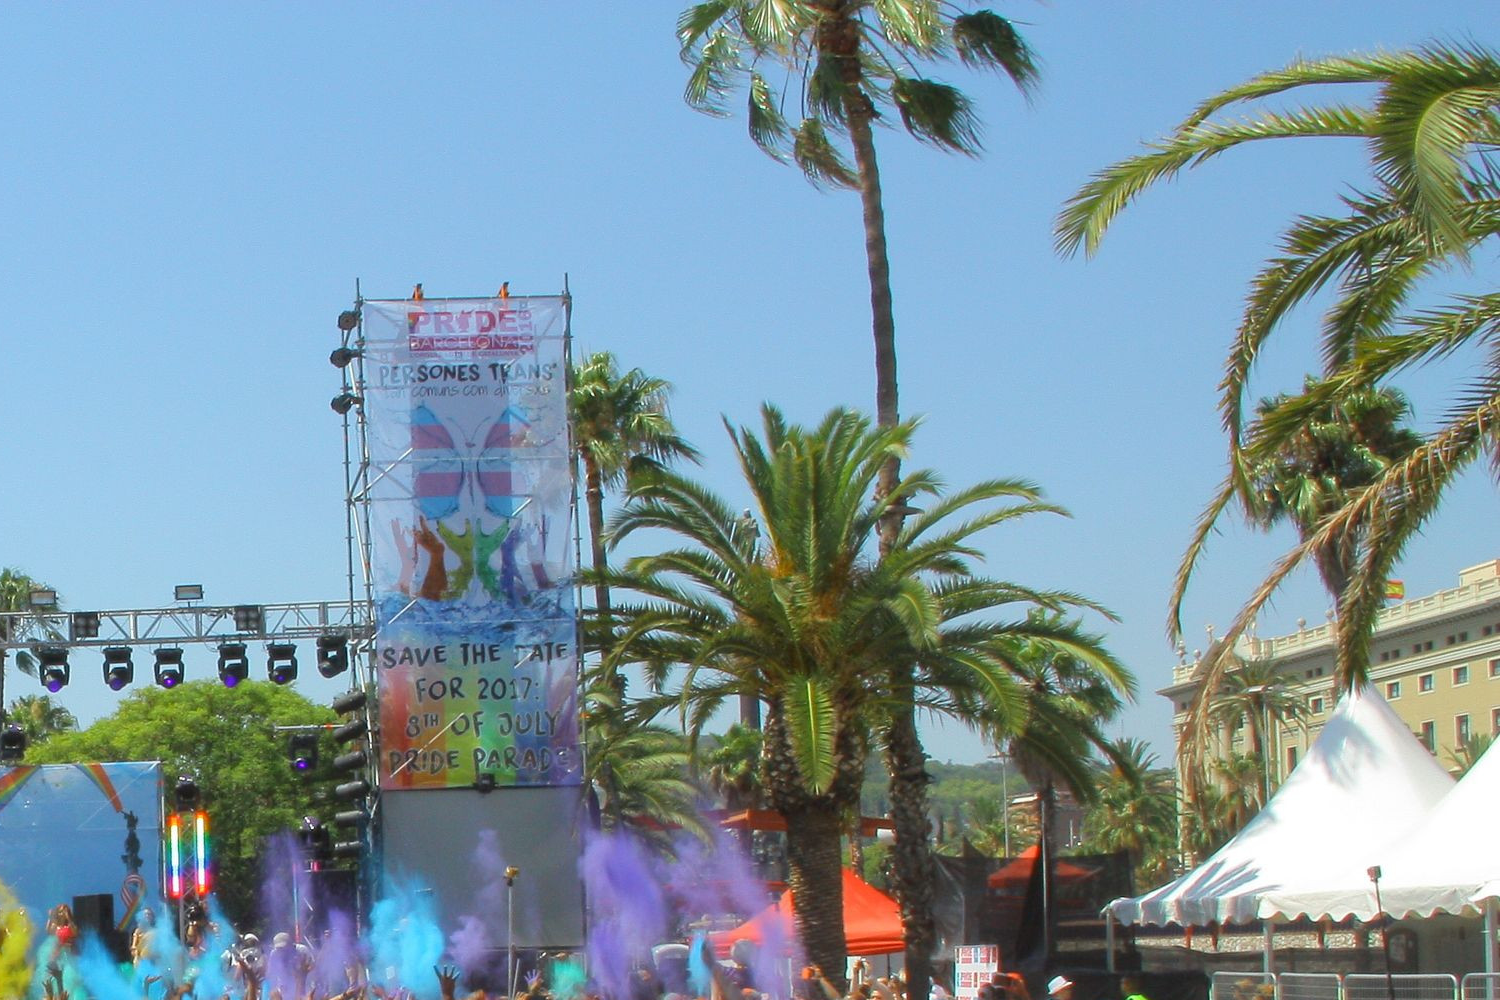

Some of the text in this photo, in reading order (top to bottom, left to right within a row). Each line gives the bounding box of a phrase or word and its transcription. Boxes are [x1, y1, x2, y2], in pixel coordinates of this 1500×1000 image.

[410, 336, 516, 351] BARCELONA
[379, 363, 480, 386] PERSONES
[462, 383, 489, 397] com
[382, 645, 447, 669] SAVE
[460, 642, 501, 667] THE
[415, 676, 540, 702] FOR 2017:
[405, 710, 561, 738] 8TH OF JULY
[389, 744, 569, 777] PRIDE PARADE
